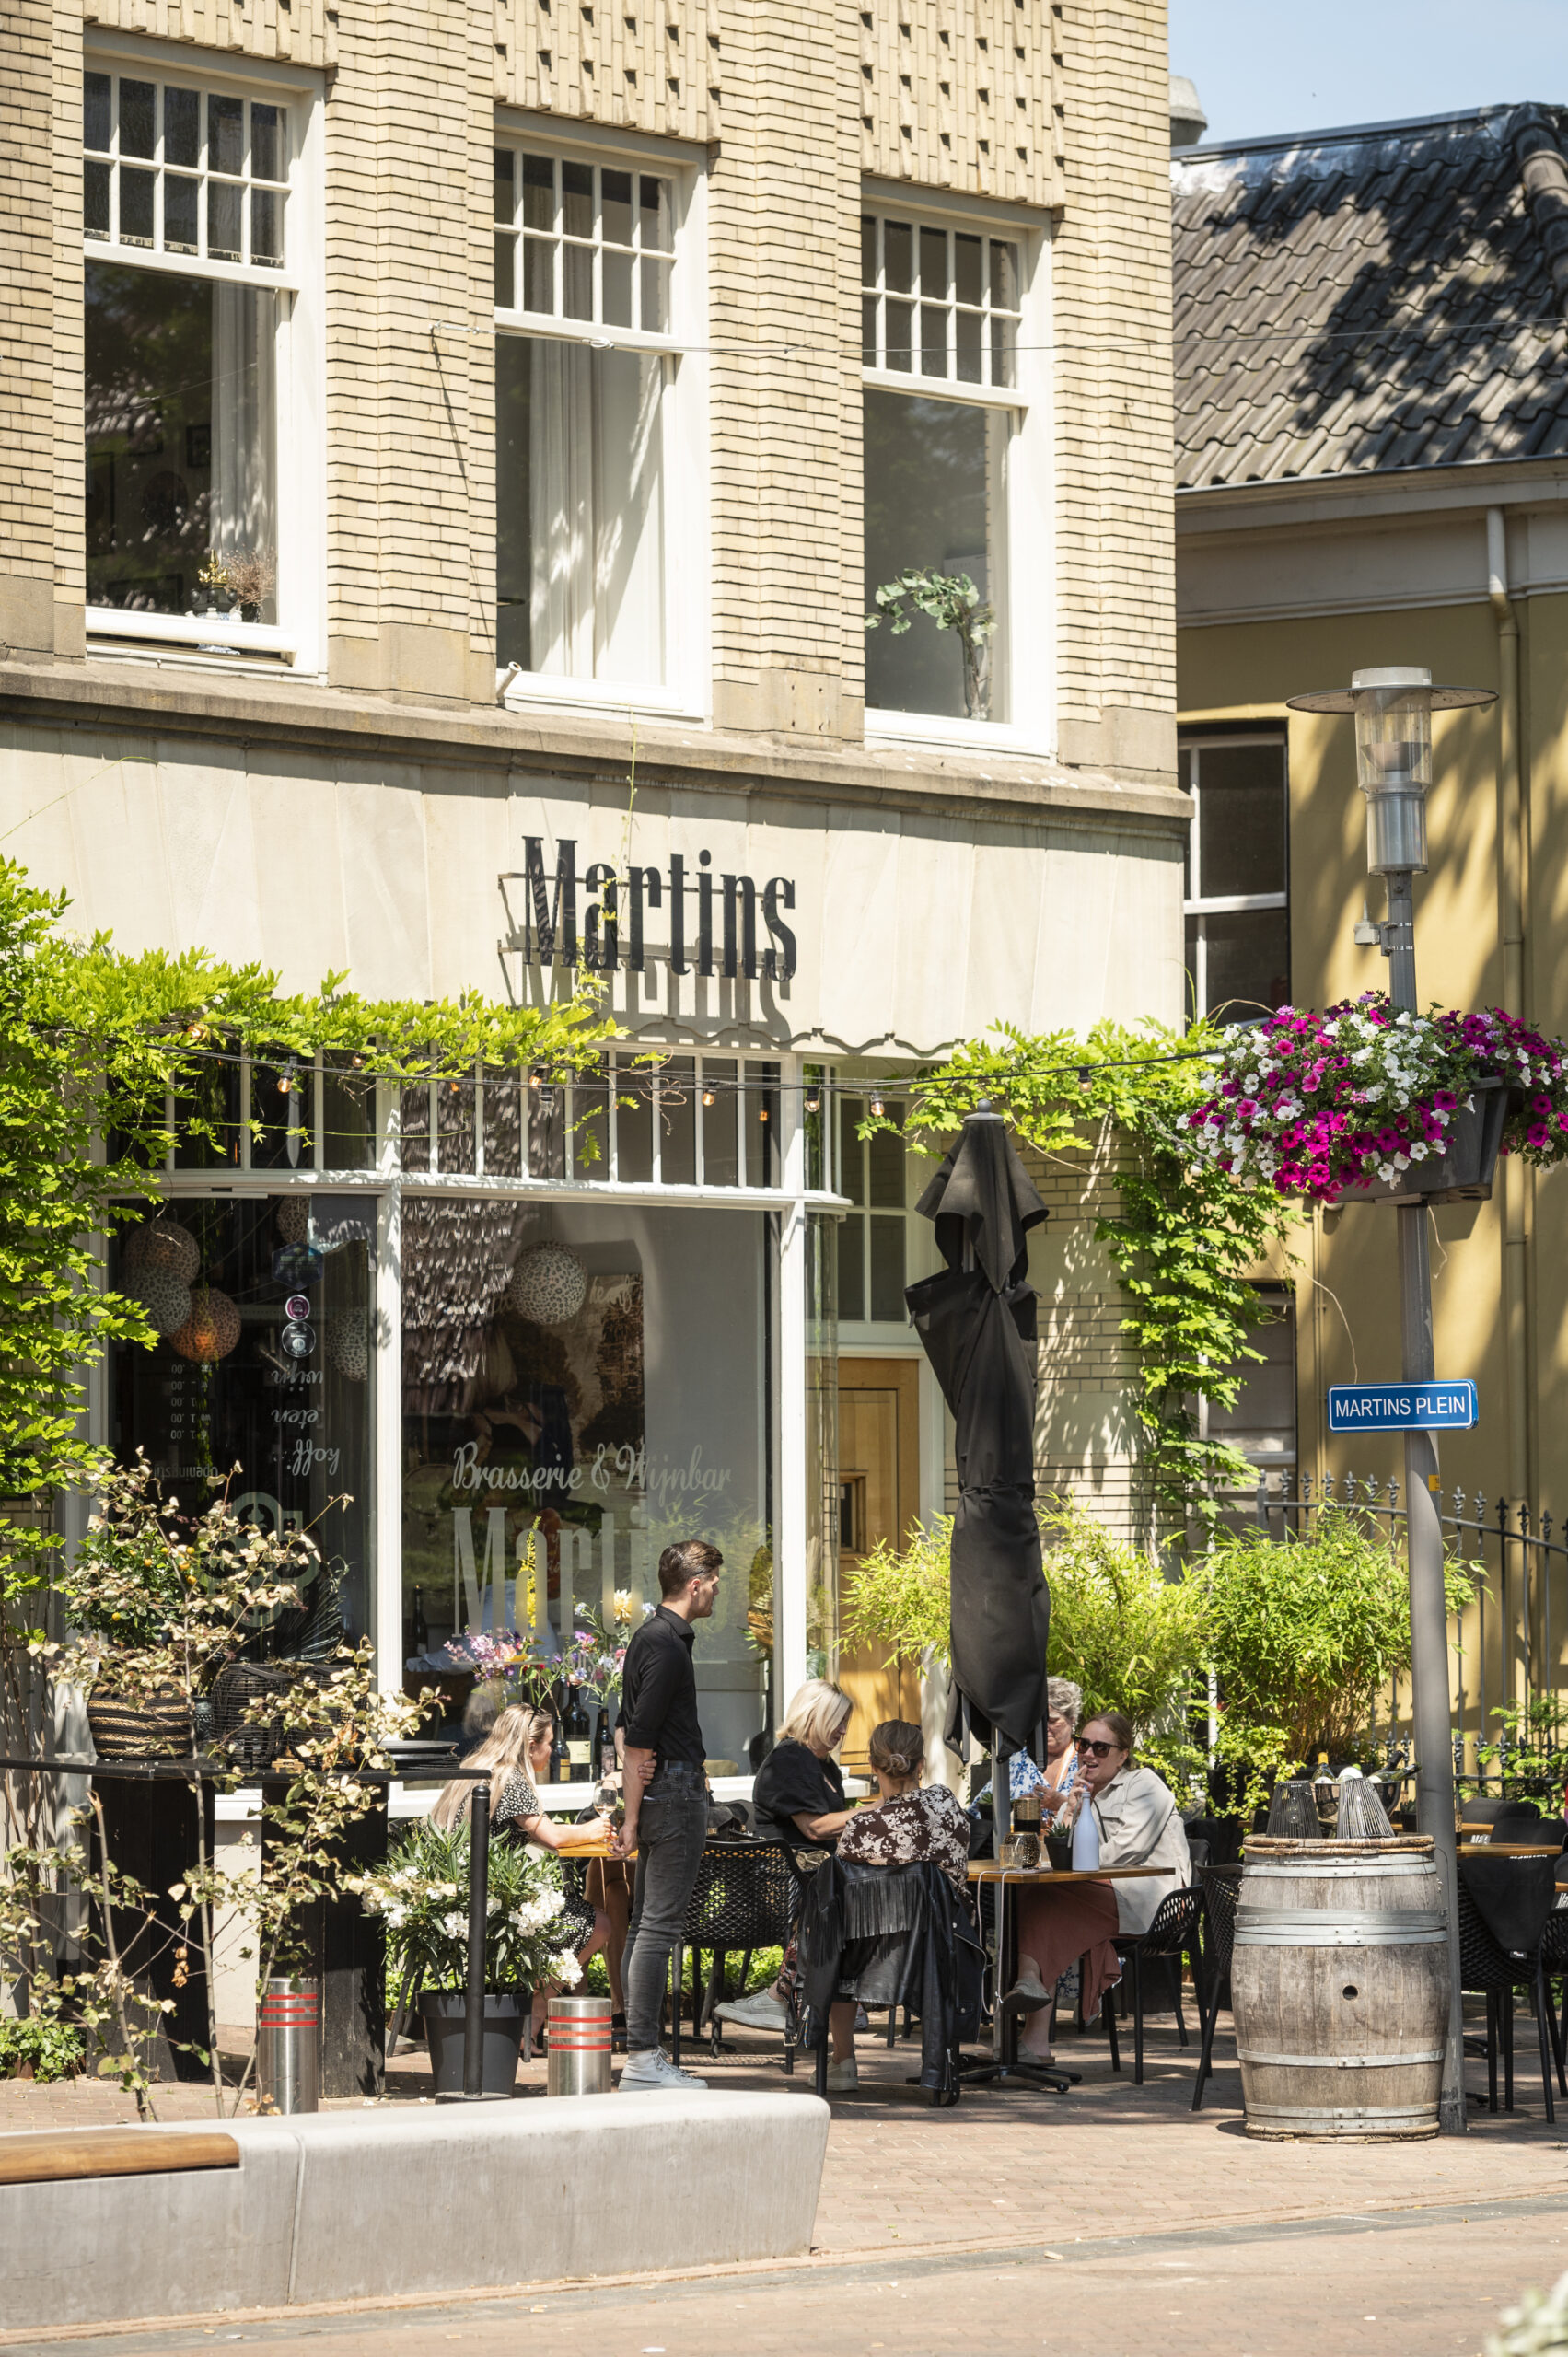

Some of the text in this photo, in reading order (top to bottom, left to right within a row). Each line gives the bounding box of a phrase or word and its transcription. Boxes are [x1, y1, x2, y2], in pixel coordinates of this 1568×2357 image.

[521, 835, 796, 982] Martins
[271, 1361, 324, 1392] wijn
[271, 1408, 319, 1430] eten
[1335, 1396, 1466, 1418] MARTINS PLEIN
[272, 1438, 340, 1477] koff
[453, 1441, 732, 1507] Brasserie & Wijnbar
